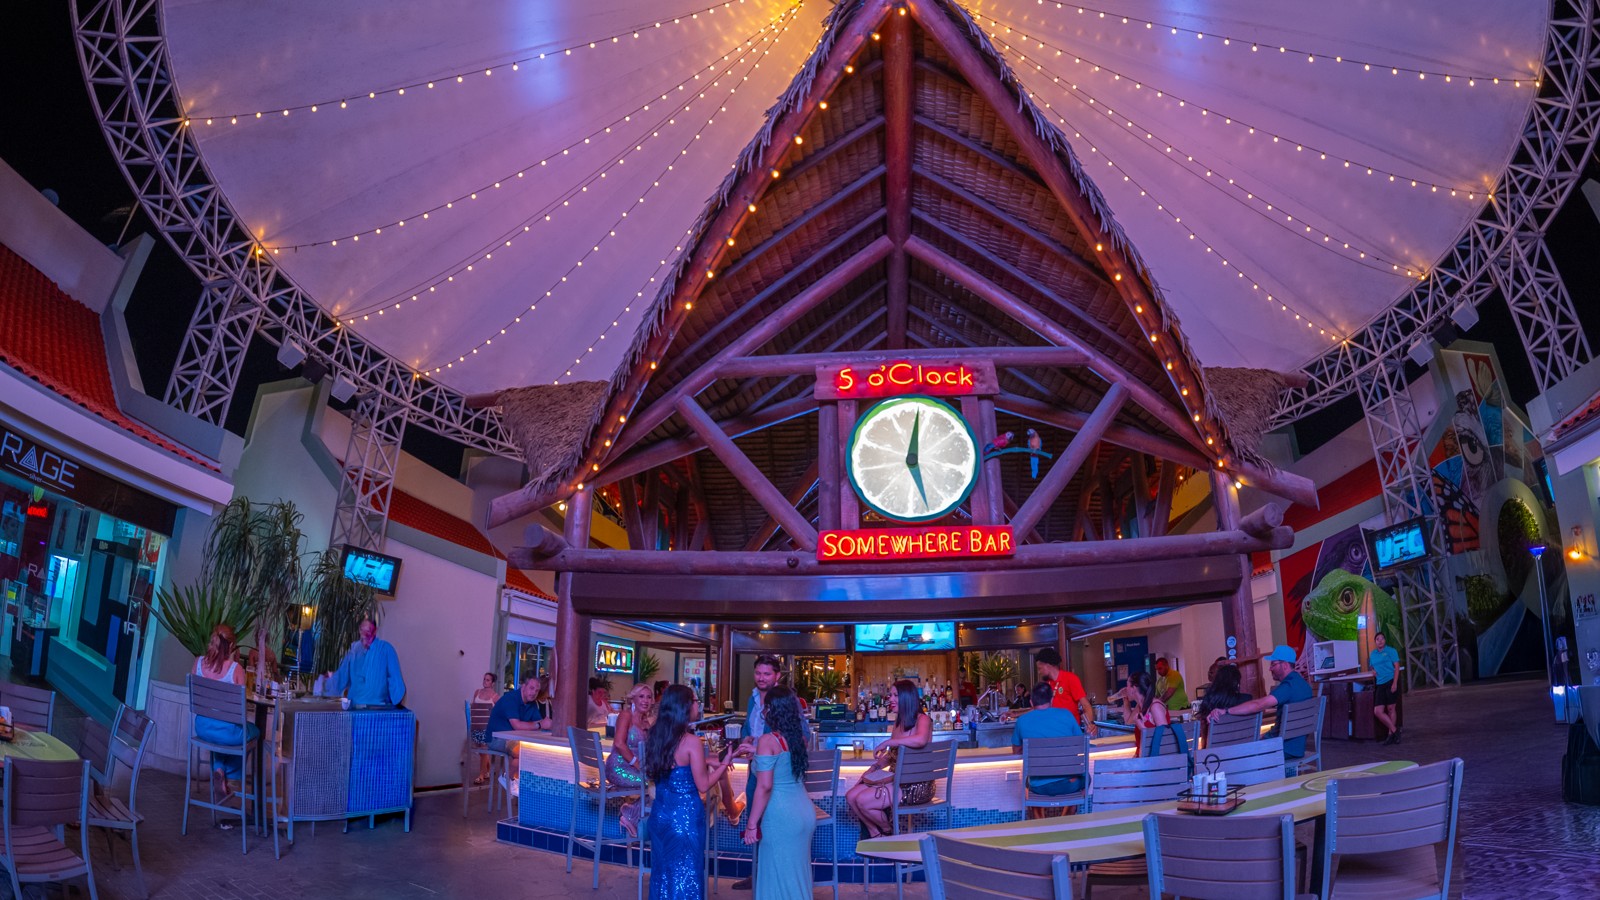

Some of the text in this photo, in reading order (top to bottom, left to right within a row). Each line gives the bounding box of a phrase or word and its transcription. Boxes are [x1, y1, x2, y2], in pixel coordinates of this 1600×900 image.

[839, 368, 853, 390] 5
[0, 431, 79, 489] RAGE
[823, 529, 1011, 557] SOMEWHERE BAR
[1376, 527, 1424, 563] UFC
[598, 649, 632, 668] ARCADE
